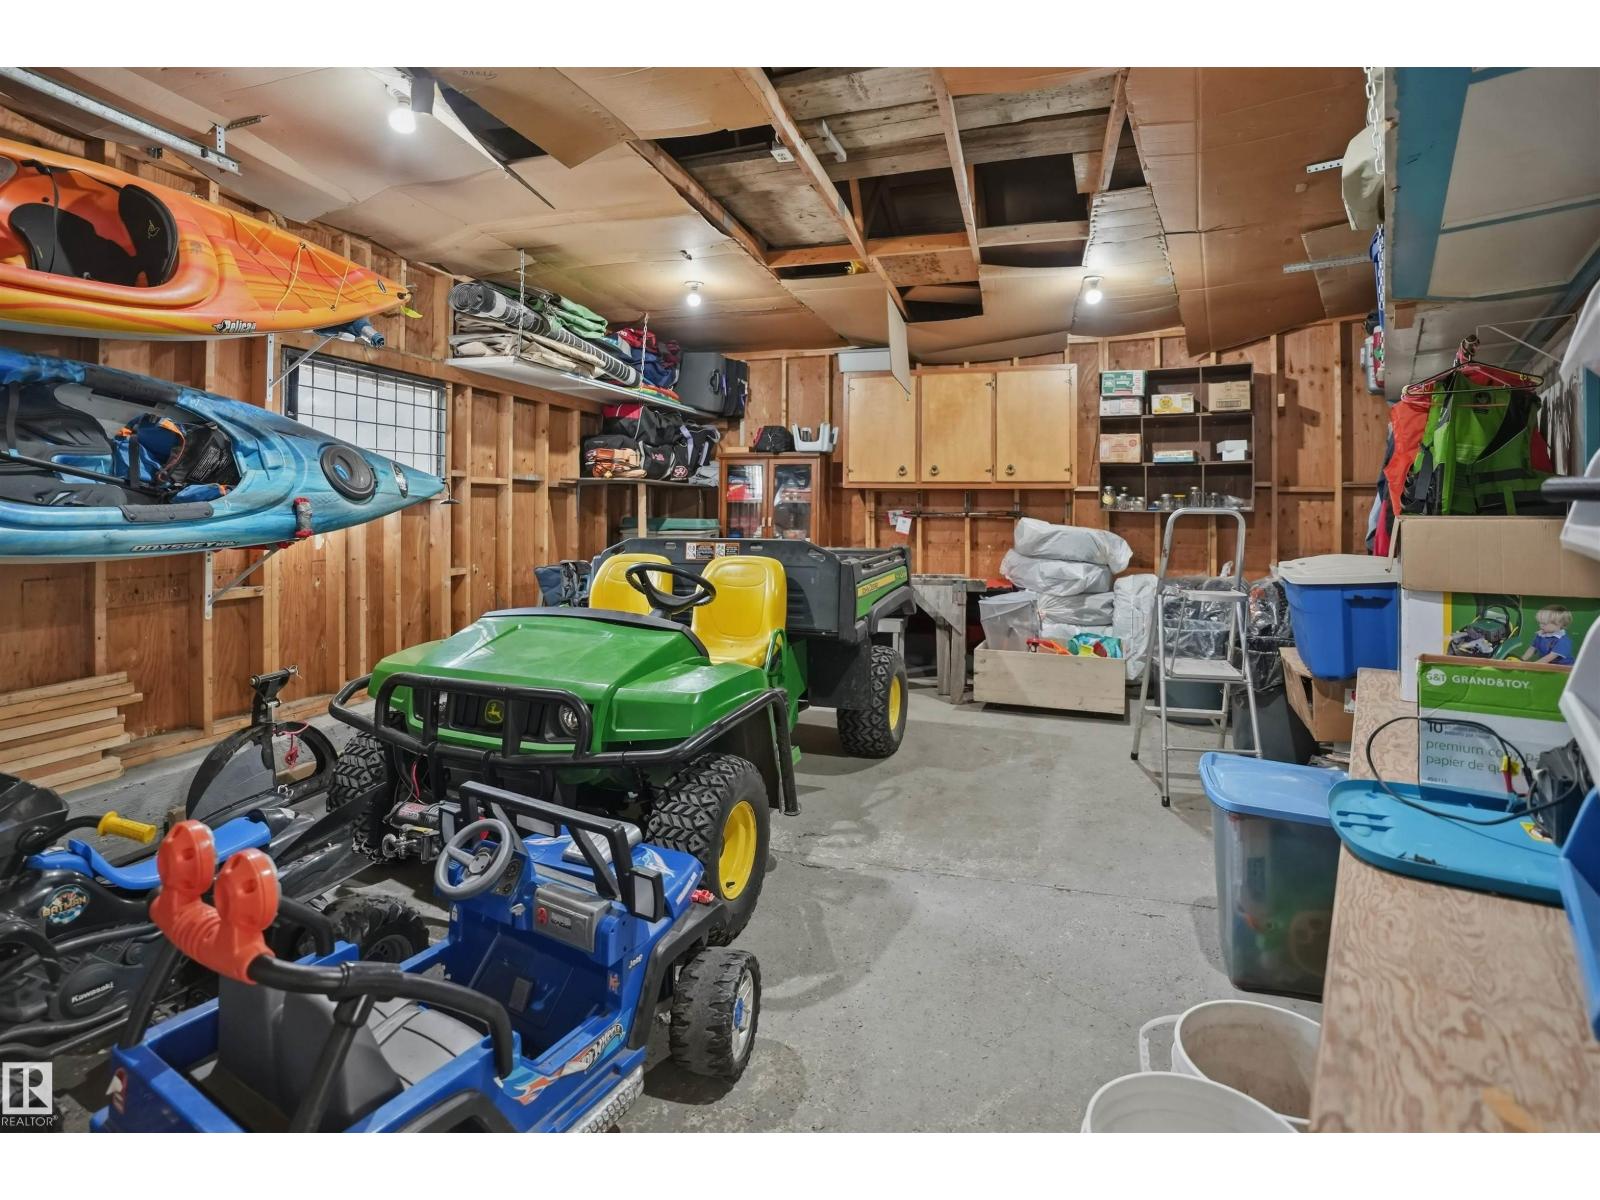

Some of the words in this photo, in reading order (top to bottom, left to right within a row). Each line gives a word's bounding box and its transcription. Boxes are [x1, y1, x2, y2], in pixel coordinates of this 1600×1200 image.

[221, 318, 257, 334] Pelican
[131, 541, 217, 552] ODYSSEY
[1451, 674, 1531, 689] GRAND&TOY
[1426, 741, 1484, 756] premium
[1426, 755, 1465, 768] papier
[1468, 758, 1485, 772] de
[71, 981, 114, 1004] Kawasaki
